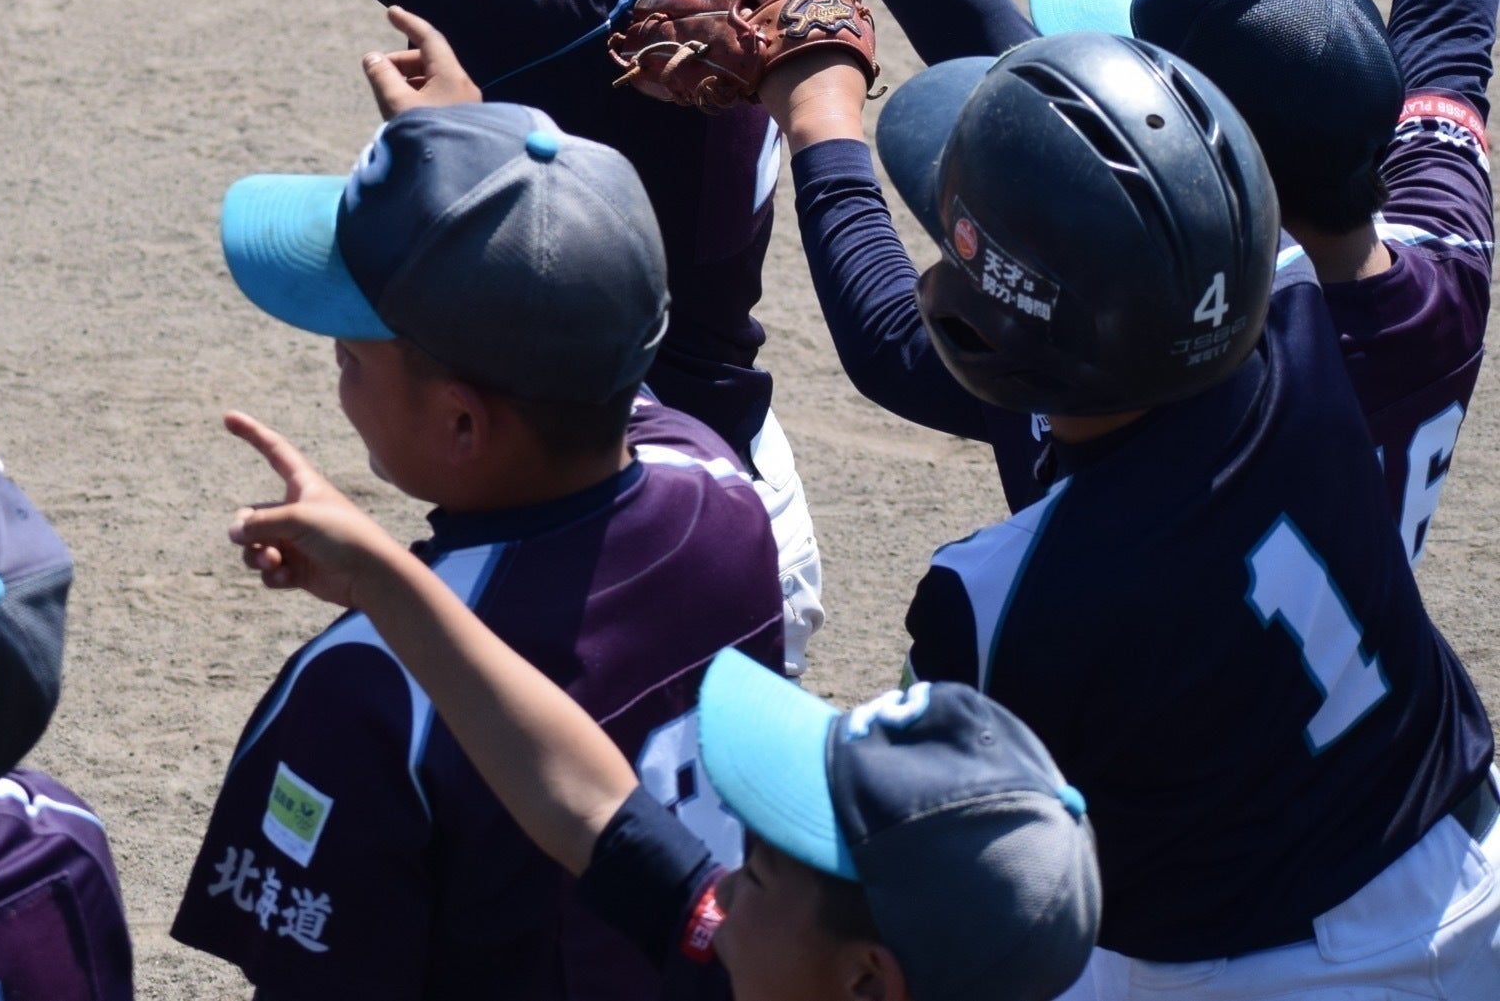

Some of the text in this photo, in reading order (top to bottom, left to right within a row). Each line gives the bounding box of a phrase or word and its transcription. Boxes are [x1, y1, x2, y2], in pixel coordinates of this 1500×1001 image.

[1437, 101, 1467, 117] JSBB
[1193, 271, 1229, 327] 4
[1243, 511, 1392, 757] 1
[208, 846, 332, 953] 北海道
